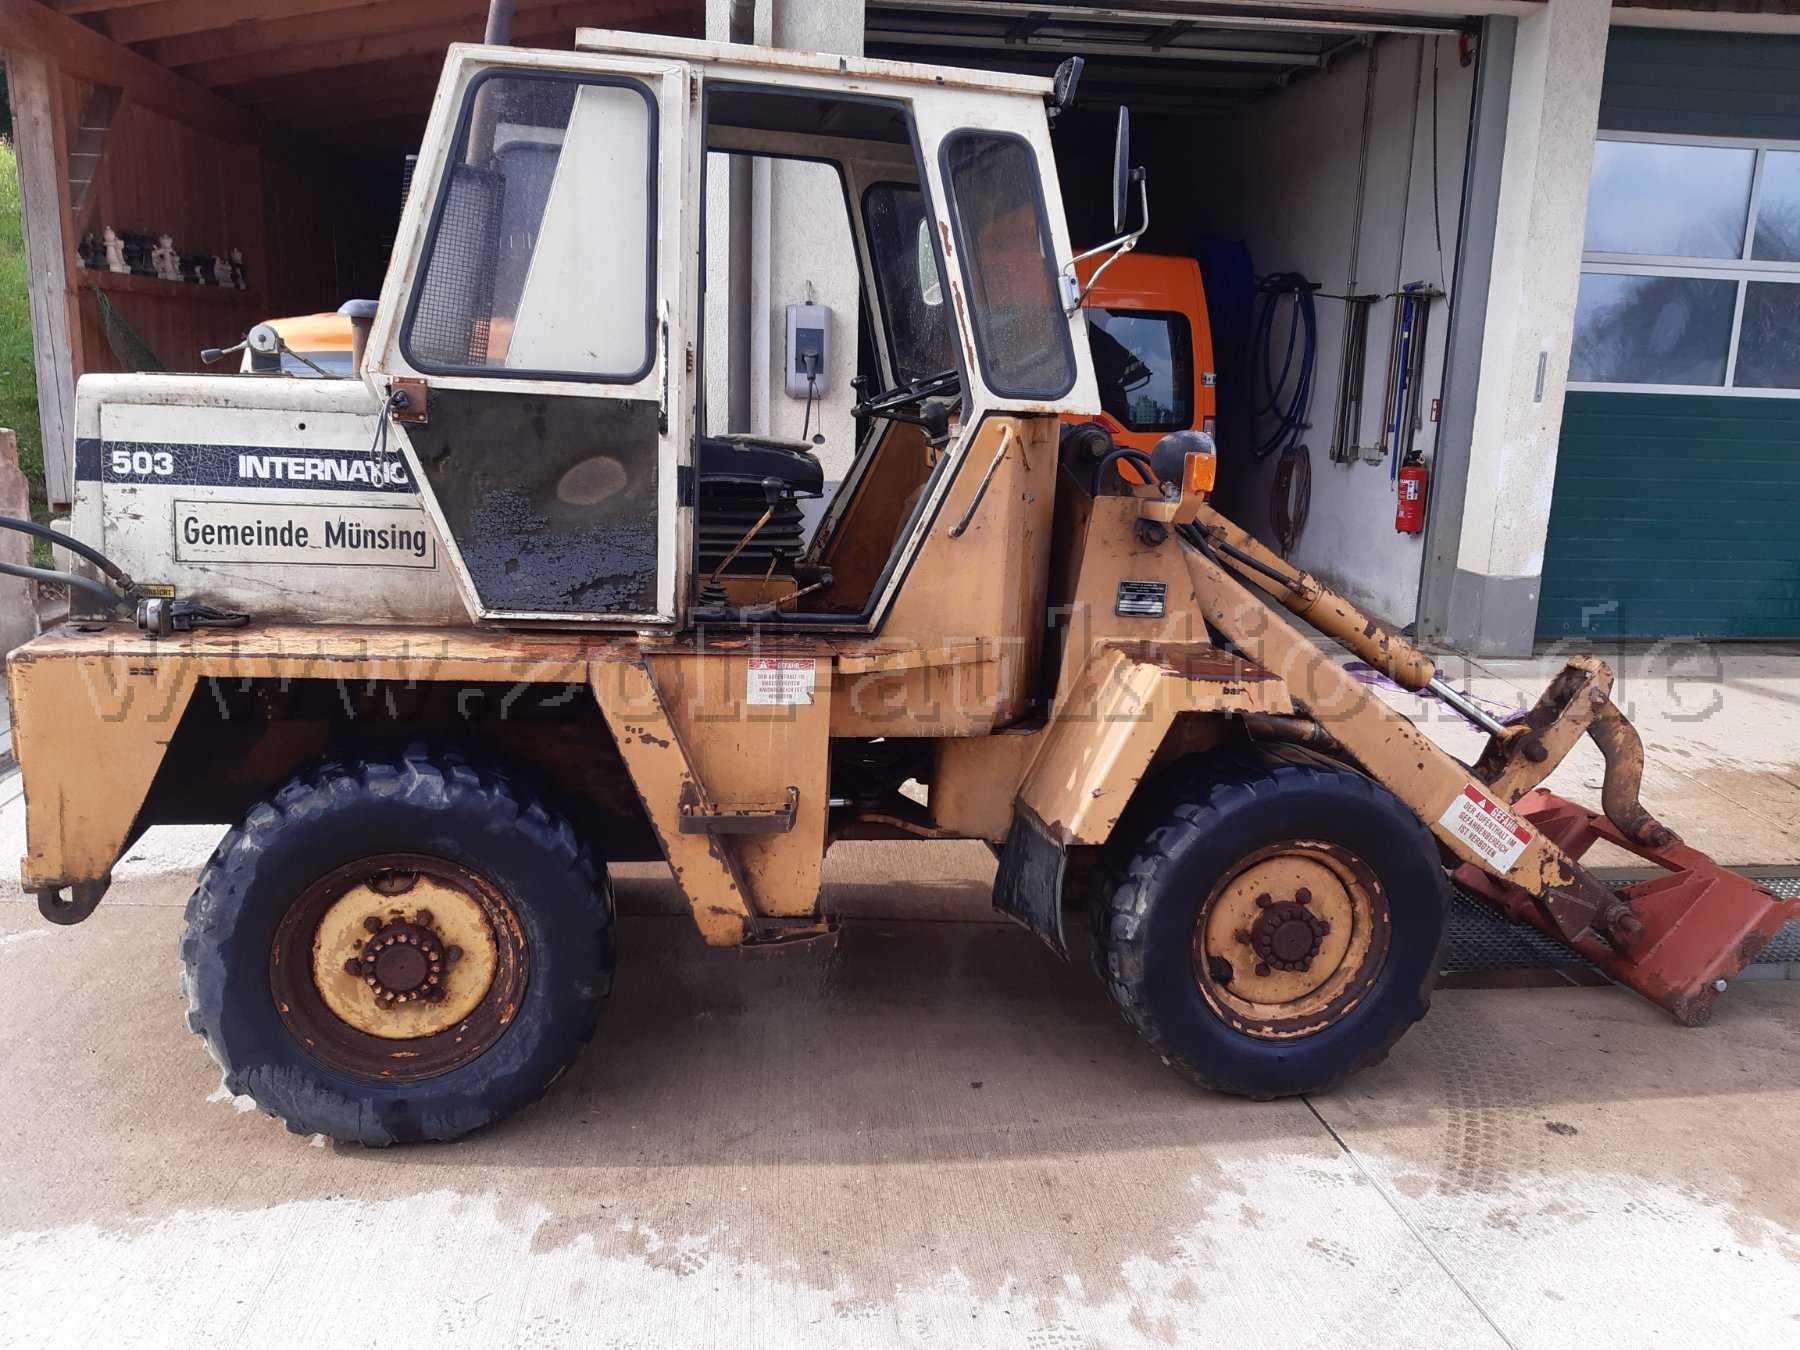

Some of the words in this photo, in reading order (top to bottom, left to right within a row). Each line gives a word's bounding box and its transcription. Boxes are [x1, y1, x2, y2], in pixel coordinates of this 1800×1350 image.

[112, 451, 174, 476] 503
[183, 515, 310, 548] Gemeinde
[324, 519, 427, 559] Münsing
[1458, 811, 1509, 855] GEFAHRENBEREICH
[1463, 801, 1477, 815] DER
[1475, 811, 1508, 841] AUFENTHALT
[1507, 838, 1517, 848] IM
[1491, 807, 1518, 833] GEFAHR
[1458, 823, 1470, 836] IST
[1468, 832, 1497, 858] VERBOTEN
